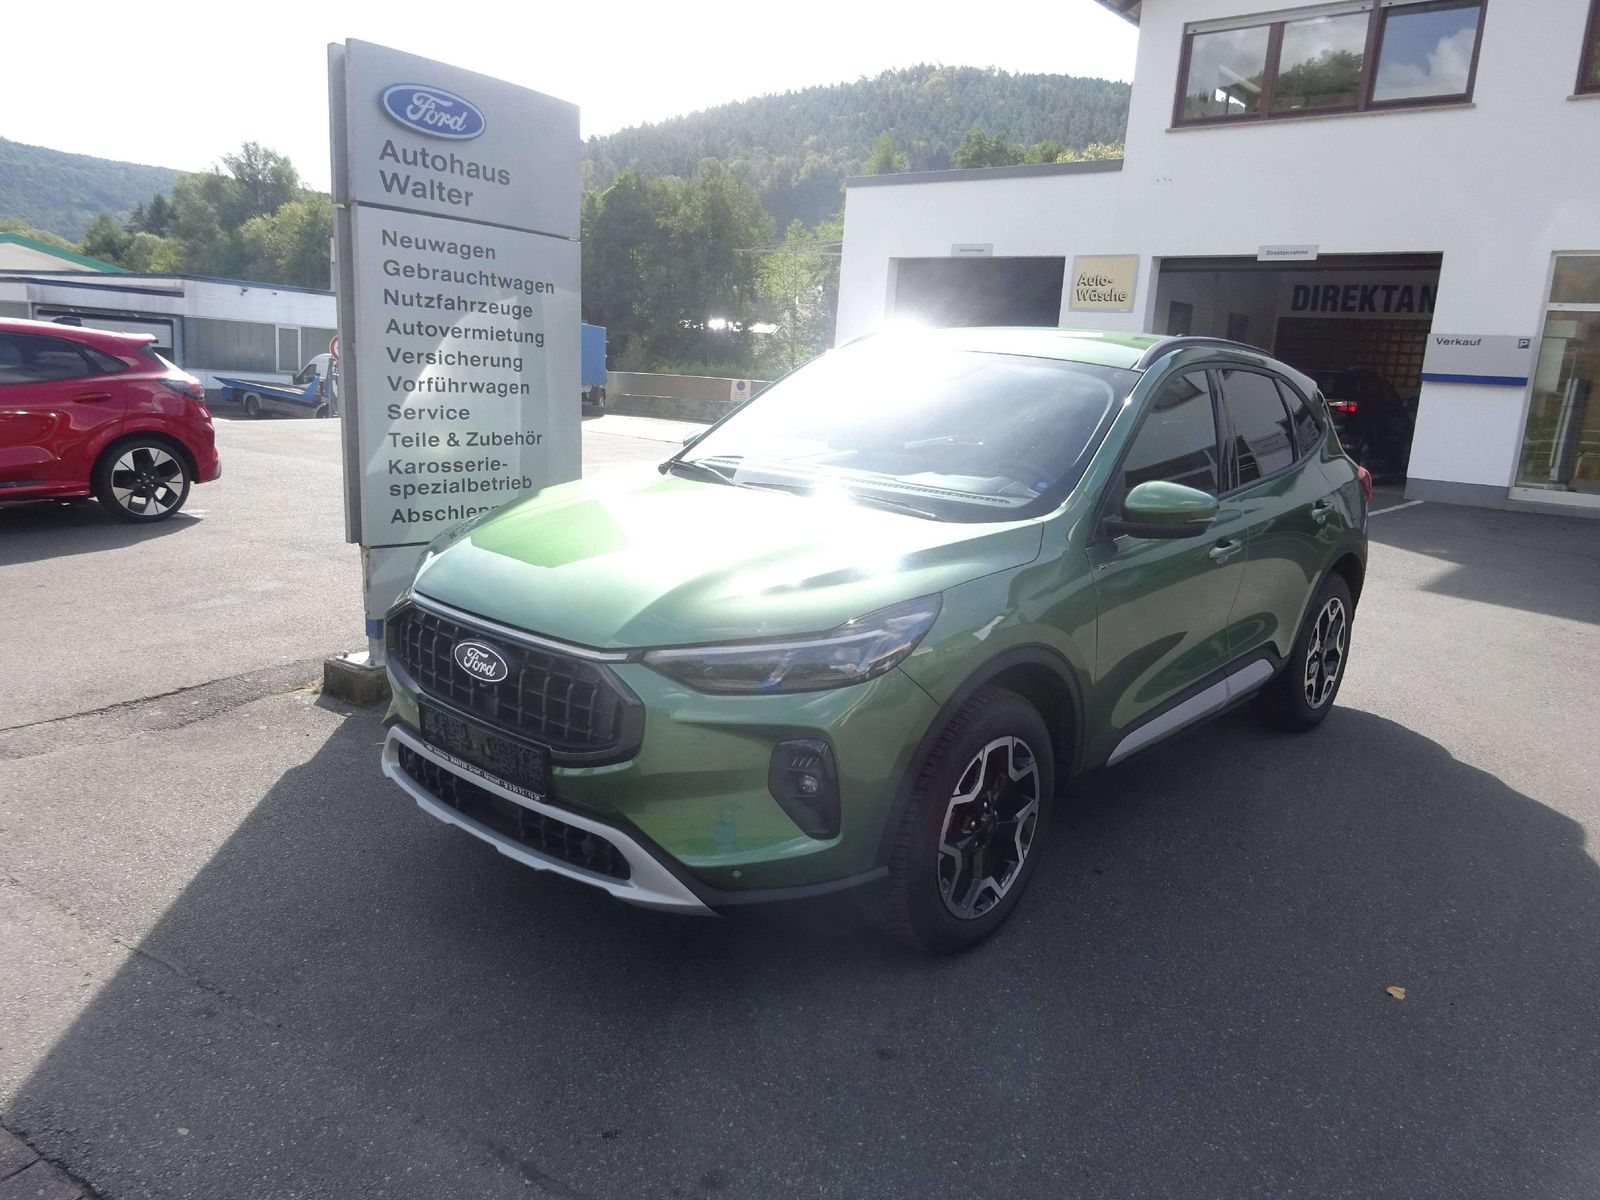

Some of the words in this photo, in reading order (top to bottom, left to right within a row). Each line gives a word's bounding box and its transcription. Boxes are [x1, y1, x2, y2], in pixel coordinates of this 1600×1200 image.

[405, 92, 468, 132] Ford
[379, 139, 511, 186] Autohaus
[379, 169, 474, 207] Walter
[381, 229, 496, 260] Neuwagen
[383, 259, 555, 294] Gebrauchtwagen
[1076, 274, 1113, 287] Auto-
[383, 288, 533, 319] Nutzfahrzeuge
[1076, 288, 1128, 302] Wäsche
[386, 318, 545, 348] Autovermietung
[1436, 336, 1482, 347] Verkauf
[386, 347, 523, 372] Versicherung
[387, 375, 530, 398] Vorführwagen
[387, 404, 471, 420] Service
[388, 432, 440, 448] Teile
[447, 432, 460, 447] &
[466, 430, 543, 447] Zubehör
[388, 458, 508, 475] Karosserie-
[389, 475, 532, 499] spezialbetrieb
[463, 647, 497, 678] Ford
